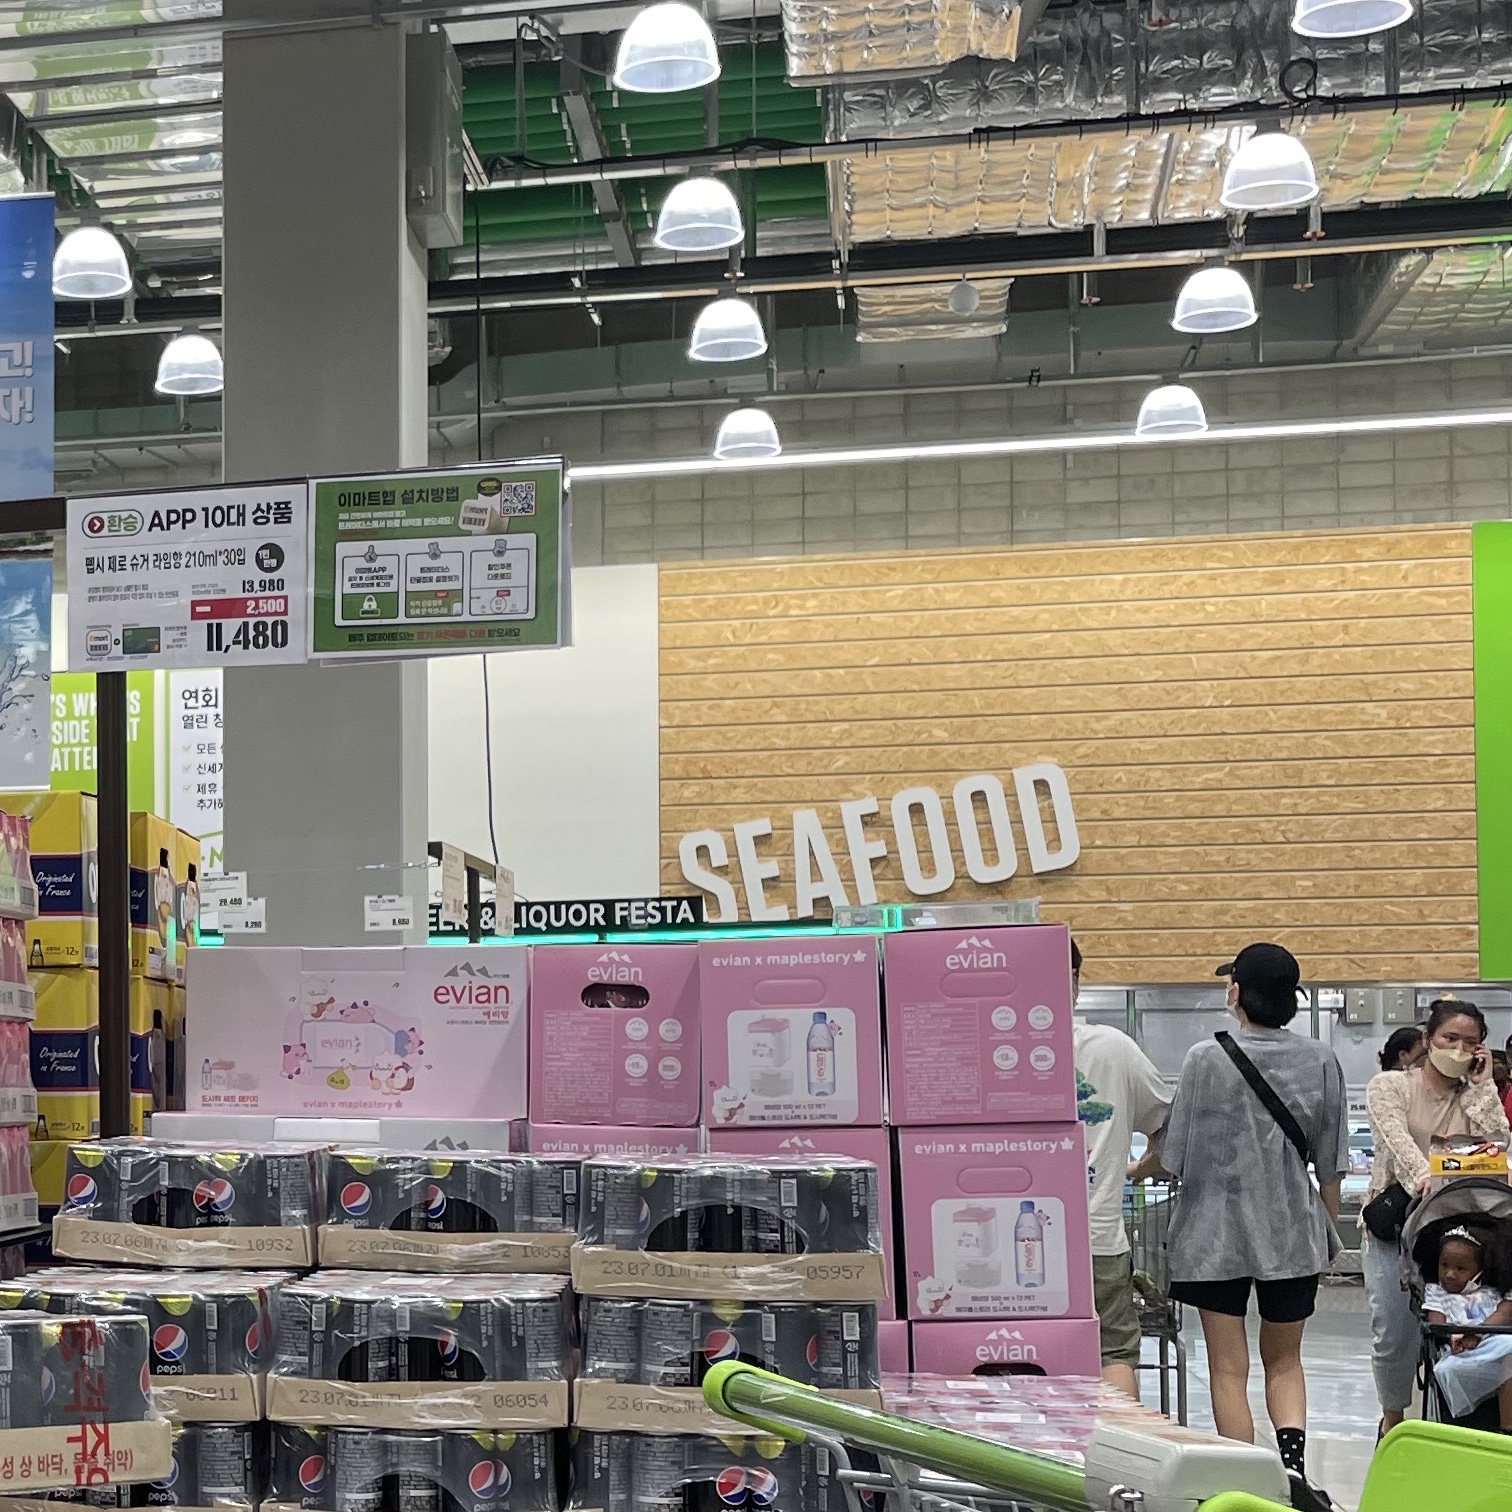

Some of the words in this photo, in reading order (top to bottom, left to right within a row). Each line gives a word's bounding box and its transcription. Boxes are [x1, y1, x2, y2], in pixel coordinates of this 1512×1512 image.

[338, 490, 396, 507] 이마트앱
[401, 486, 459, 504] 설치방법
[107, 513, 138, 533] 환승
[148, 509, 197, 532] APP
[201, 504, 246, 529] 10대
[252, 500, 293, 526] 상품
[107, 555, 128, 573] 제로
[129, 553, 150, 572] 슈거
[152, 551, 183, 570] 라임향
[242, 578, 285, 594] 13,980
[246, 599, 285, 615] 2,500
[206, 619, 289, 654] 11,480
[182, 687, 218, 709] 연회
[197, 743, 216, 754] 모든
[679, 763, 1081, 923] SEAFOOD
[36, 871, 76, 887] Originated
[46, 885, 72, 896] France
[513, 903, 606, 932] IQUOR
[615, 900, 694, 925] FESTA
[712, 953, 751, 967] evian
[755, 956, 763, 965] x
[767, 950, 850, 967] maplestory
[945, 949, 1007, 969] evian
[588, 964, 642, 982] evian
[433, 980, 511, 1005] evian
[321, 1036, 353, 1050] evian
[40, 1046, 80, 1061] Originated
[50, 1062, 76, 1072] France
[543, 1140, 574, 1153] evian
[579, 1143, 589, 1152] x
[593, 1142, 673, 1156] maplestory
[915, 1141, 954, 1155] evian
[958, 1143, 967, 1151] x
[972, 1138, 1058, 1154] maplestory
[247, 1237, 294, 1252] 10932
[806, 1264, 865, 1279] 05957
[976, 1342, 1036, 1361] evian
[493, 1393, 549, 1409] 06054
[20, 1455, 32, 1479] 상
[38, 1454, 68, 1477] 바닥,
